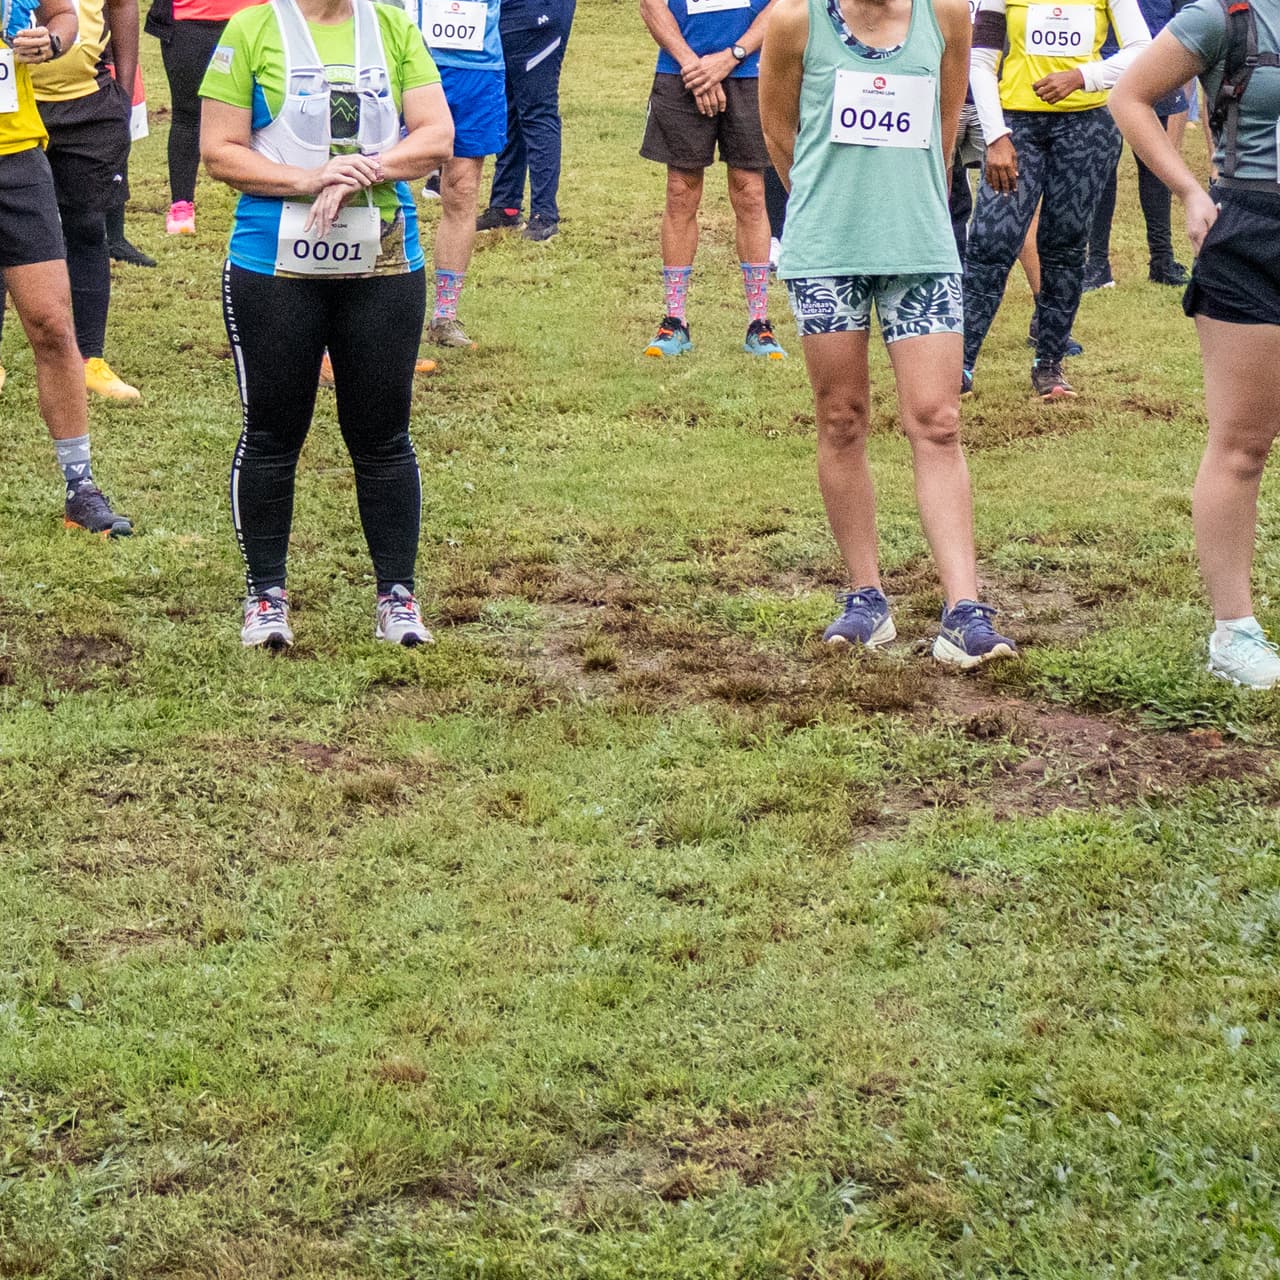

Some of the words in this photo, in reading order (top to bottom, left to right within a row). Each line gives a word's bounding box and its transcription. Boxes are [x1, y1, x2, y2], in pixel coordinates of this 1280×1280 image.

[432, 23, 477, 41] 0007
[1031, 29, 1082, 47] 0050
[840, 107, 911, 133] 0046
[293, 239, 363, 261] 0001
[223, 273, 241, 343] RUNNING
